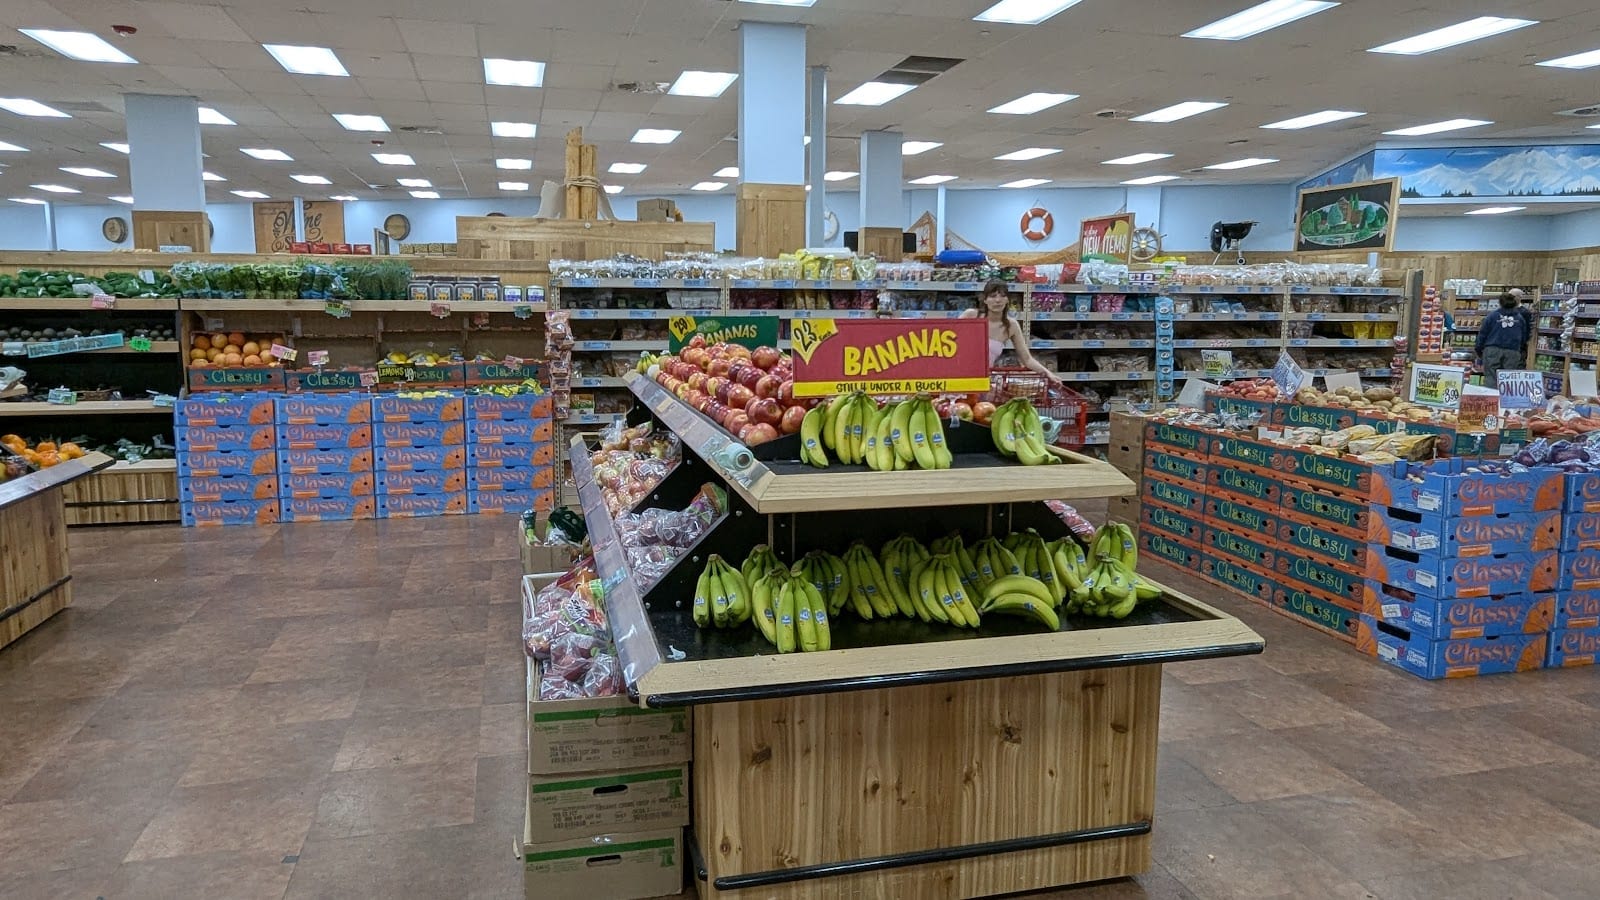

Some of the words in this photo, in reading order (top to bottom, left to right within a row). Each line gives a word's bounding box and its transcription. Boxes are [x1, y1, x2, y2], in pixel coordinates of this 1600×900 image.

[1083, 236, 1100, 256] NEW
[1102, 233, 1128, 254] ITEMS
[843, 328, 958, 376] BANANAS
[211, 370, 262, 385] Classy
[379, 367, 404, 376] LEMONS
[307, 373, 355, 387] Classy
[870, 382, 902, 392] UNDER
[904, 382, 912, 391] A
[915, 381, 947, 391] BUCK!
[1499, 380, 1543, 397] ONIONS
[184, 402, 244, 417] Classy
[285, 402, 342, 416] Classy
[381, 399, 436, 414] Classy
[474, 397, 526, 411] Classy
[1289, 405, 1333, 430] Classy
[186, 427, 245, 442] Classy
[286, 426, 343, 441] Classy
[383, 425, 437, 439] Classy
[475, 422, 528, 436] Classy
[1159, 424, 1195, 449] Classy
[288, 451, 345, 466] Classy
[384, 449, 438, 464] Classy
[475, 445, 528, 459] Classy
[1226, 438, 1266, 467] Classy
[187, 453, 247, 469] Classy
[1157, 454, 1191, 479] Classy
[475, 469, 528, 483] Classy
[1303, 455, 1352, 487] Classy
[190, 478, 249, 493] Classy
[289, 475, 346, 490] Classy
[385, 473, 439, 488] Classy
[1223, 470, 1263, 497] Classy
[1156, 481, 1189, 506] Classy
[1458, 478, 1530, 503] Classy
[291, 499, 348, 513] Classy
[386, 497, 440, 511] Classy
[477, 493, 529, 507] Classy
[192, 503, 251, 519] Classy
[1220, 501, 1260, 529] Classy
[1300, 492, 1351, 525] Classy
[1154, 508, 1187, 535] Classy
[1455, 519, 1529, 543] Classy
[1152, 535, 1185, 564] Classy
[1218, 530, 1257, 561] Classy
[1298, 526, 1349, 560] Classy
[1217, 561, 1255, 592] Classy
[1295, 558, 1343, 594] Classy
[1453, 559, 1526, 588] Classy
[1292, 592, 1340, 628] Classy
[1450, 602, 1522, 626] Classy
[1445, 643, 1517, 665] Classy
